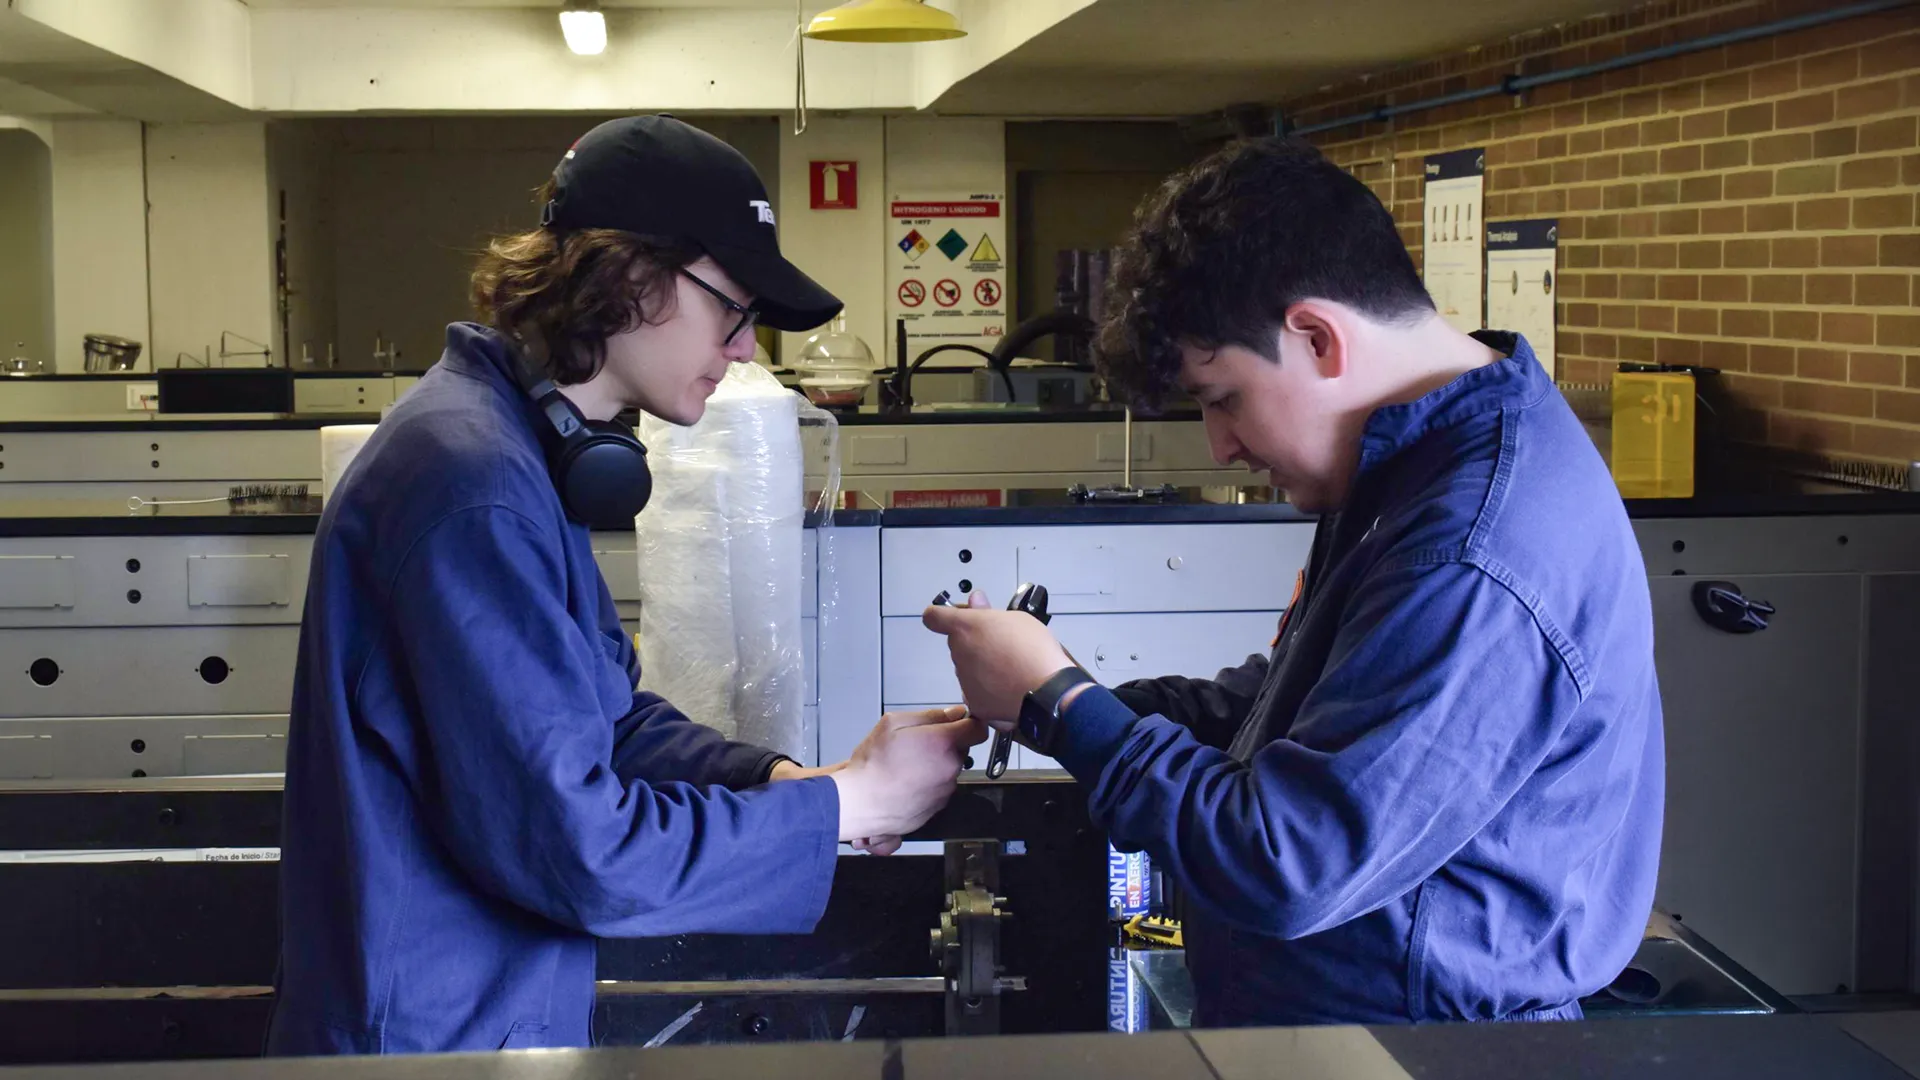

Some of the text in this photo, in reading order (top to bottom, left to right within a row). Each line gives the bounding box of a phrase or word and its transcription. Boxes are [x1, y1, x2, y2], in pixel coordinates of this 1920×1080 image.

[949, 206, 987, 214] LIQUIDO
[982, 326, 1003, 337] AGA
[1109, 842, 1126, 909] PINTU
[1129, 890, 1140, 909] EN
